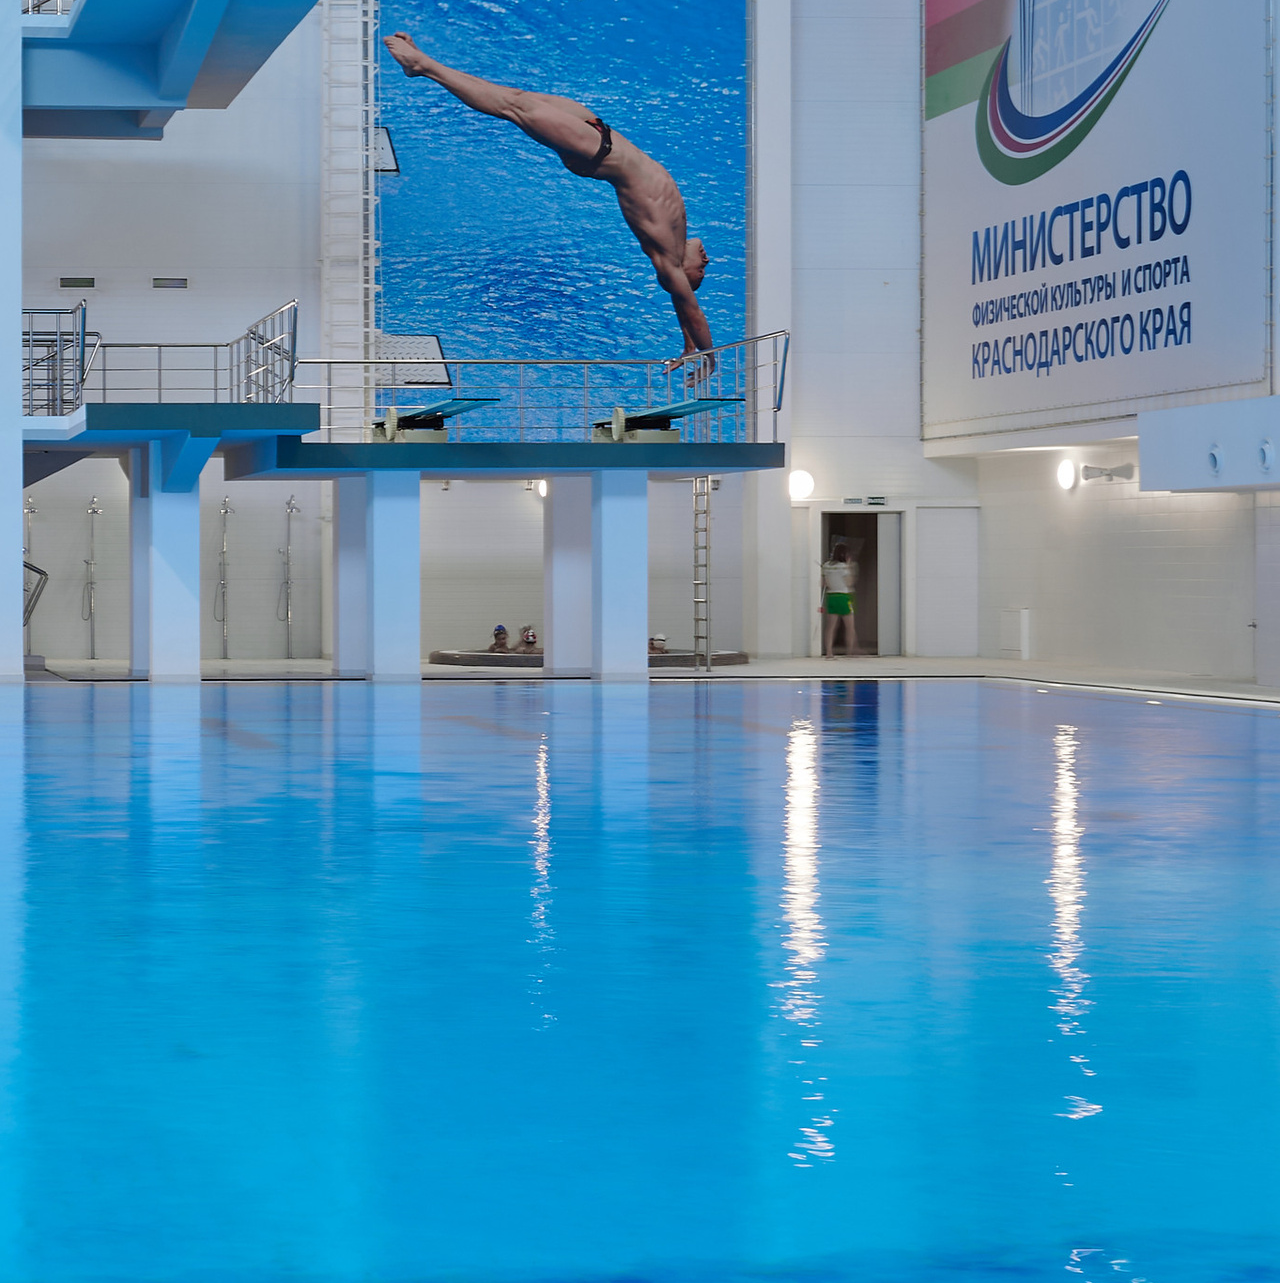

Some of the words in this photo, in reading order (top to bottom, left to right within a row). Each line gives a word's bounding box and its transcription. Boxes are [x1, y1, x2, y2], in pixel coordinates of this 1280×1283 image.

[972, 170, 1192, 285] МИНИСТЕРСТВО
[972, 283, 1049, 328] ФИЗИЧЕСКОЙ
[1050, 272, 1116, 311] КУЛЬТУРЫ
[1121, 268, 1131, 296] И
[1133, 255, 1191, 294] СПОРТА
[972, 313, 1135, 379] КРАСНОДАРСКОГО
[1139, 302, 1192, 352] КРАЯ
